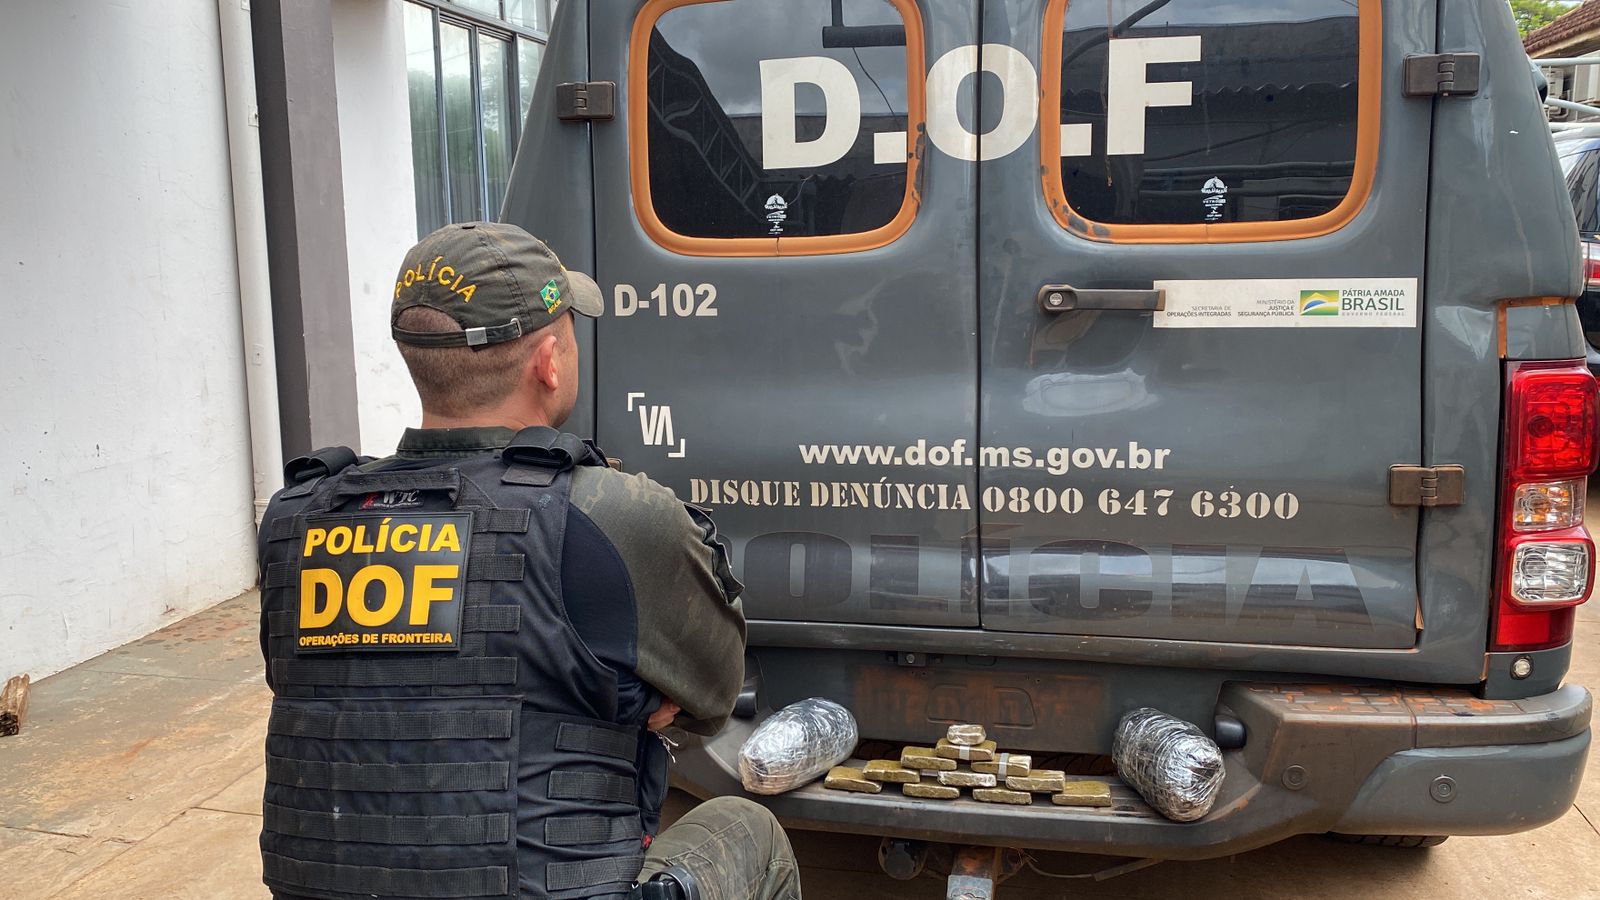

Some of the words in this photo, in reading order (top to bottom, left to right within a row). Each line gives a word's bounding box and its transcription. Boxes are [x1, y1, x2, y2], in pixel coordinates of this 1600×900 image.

[614, 283, 718, 317] D-102
[1342, 288, 1372, 297] PÁTRIA
[1374, 289, 1405, 297] AMADA
[1342, 297, 1405, 311] BRASIL
[799, 439, 1171, 476] www.dof.ms.gov.br
[690, 478, 801, 507] DISQUE
[810, 476, 972, 511] DENÚNCIA
[982, 486, 1084, 514] 0800
[1097, 488, 1175, 516] 647
[1190, 489, 1300, 520] 6300
[303, 518, 461, 557] POLÍCIA
[716, 523, 1374, 631] OLÍCIA
[299, 564, 459, 629] DOF
[299, 632, 360, 648] OPERAÇÕES
[362, 633, 378, 644] DE
[381, 632, 453, 644] FRONTEIRA
